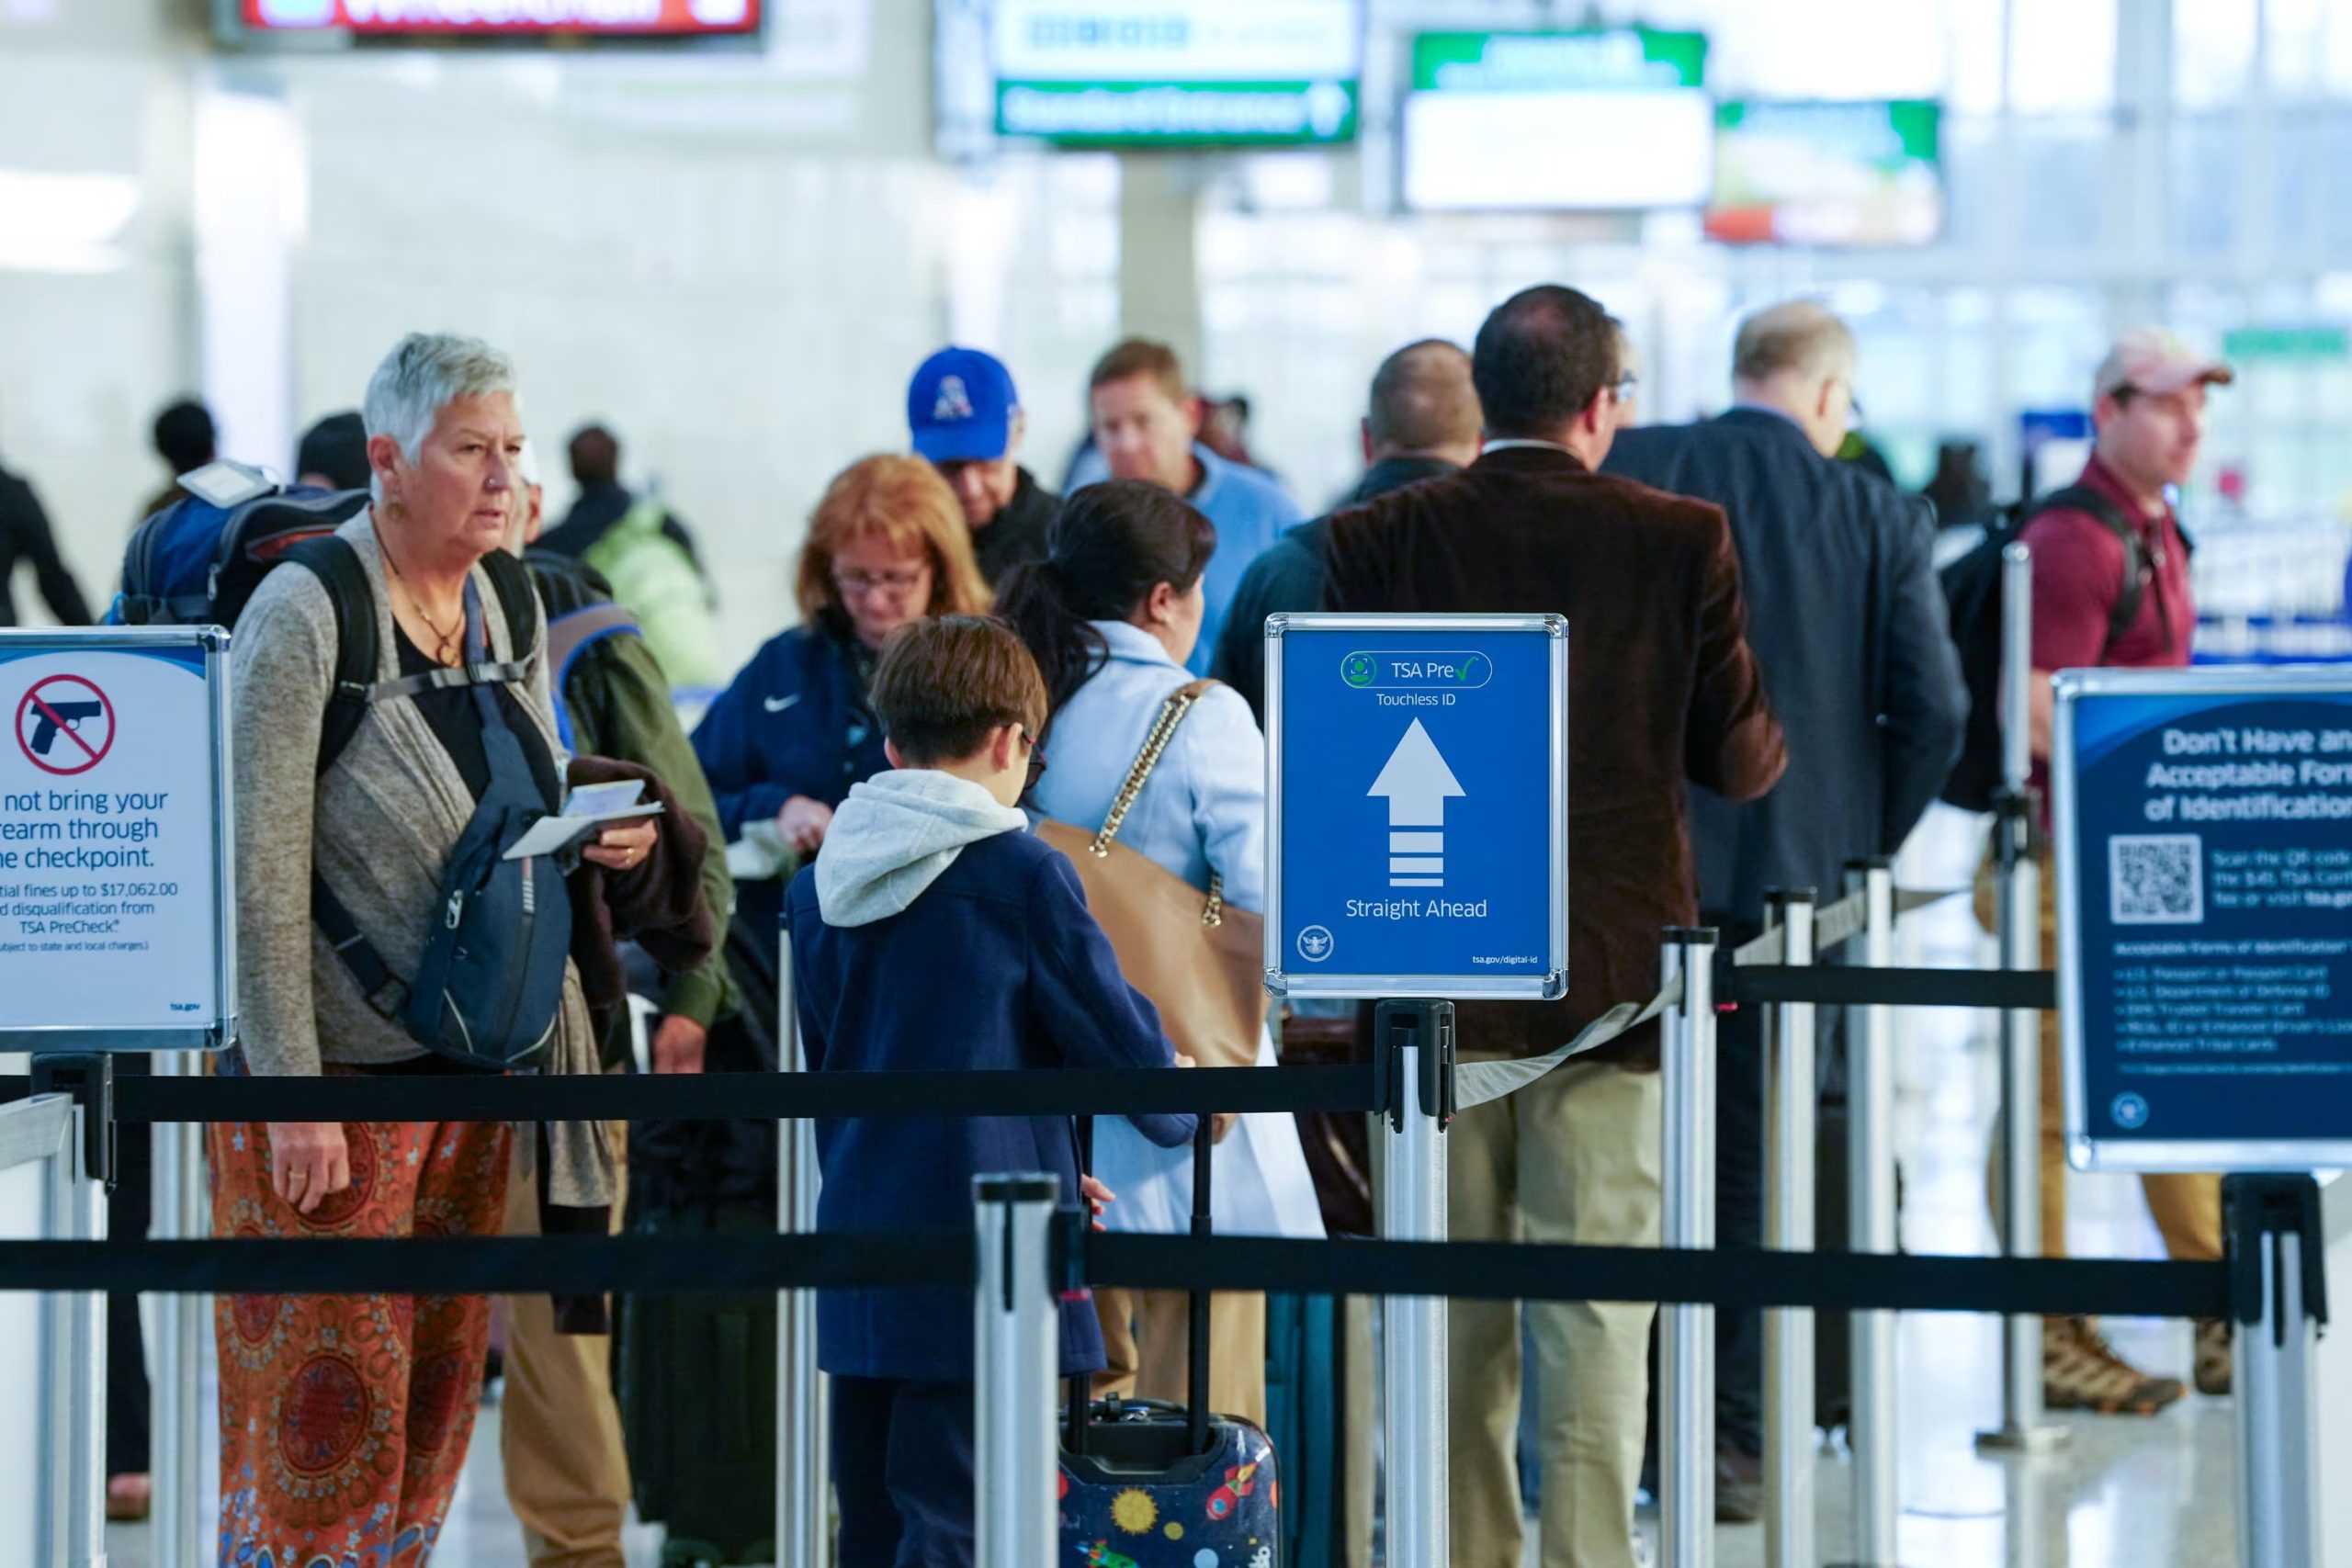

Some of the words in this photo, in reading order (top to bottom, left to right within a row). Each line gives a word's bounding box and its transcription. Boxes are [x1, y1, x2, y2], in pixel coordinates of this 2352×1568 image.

[1390, 661, 1423, 679] TSA
[1376, 693, 1439, 706] Touchless
[1442, 694, 1456, 706] ID
[2163, 728, 2236, 754] Don't
[2240, 728, 2314, 753] Have
[2146, 761, 2295, 790] Acceptable
[5, 791, 41, 811] not
[49, 789, 108, 814] bring
[115, 793, 168, 814] your
[2144, 795, 2176, 820] of
[0, 823, 62, 840] earm
[68, 818, 158, 842] through
[25, 845, 154, 871] checkpoint.
[24, 884, 57, 897] fines
[61, 886, 78, 898] up
[83, 885, 96, 897] to
[100, 883, 178, 898] $17,062.00
[12, 901, 118, 917] disqualification
[121, 901, 154, 915] from
[1346, 899, 1421, 920] Straight
[1425, 899, 1487, 918] Ahead
[19, 920, 45, 934] TSA
[28, 942, 38, 952] to
[40, 942, 62, 952] state
[65, 942, 82, 952] and
[85, 941, 106, 952] local
[1473, 955, 1538, 965] tsa.gov/digital-id
